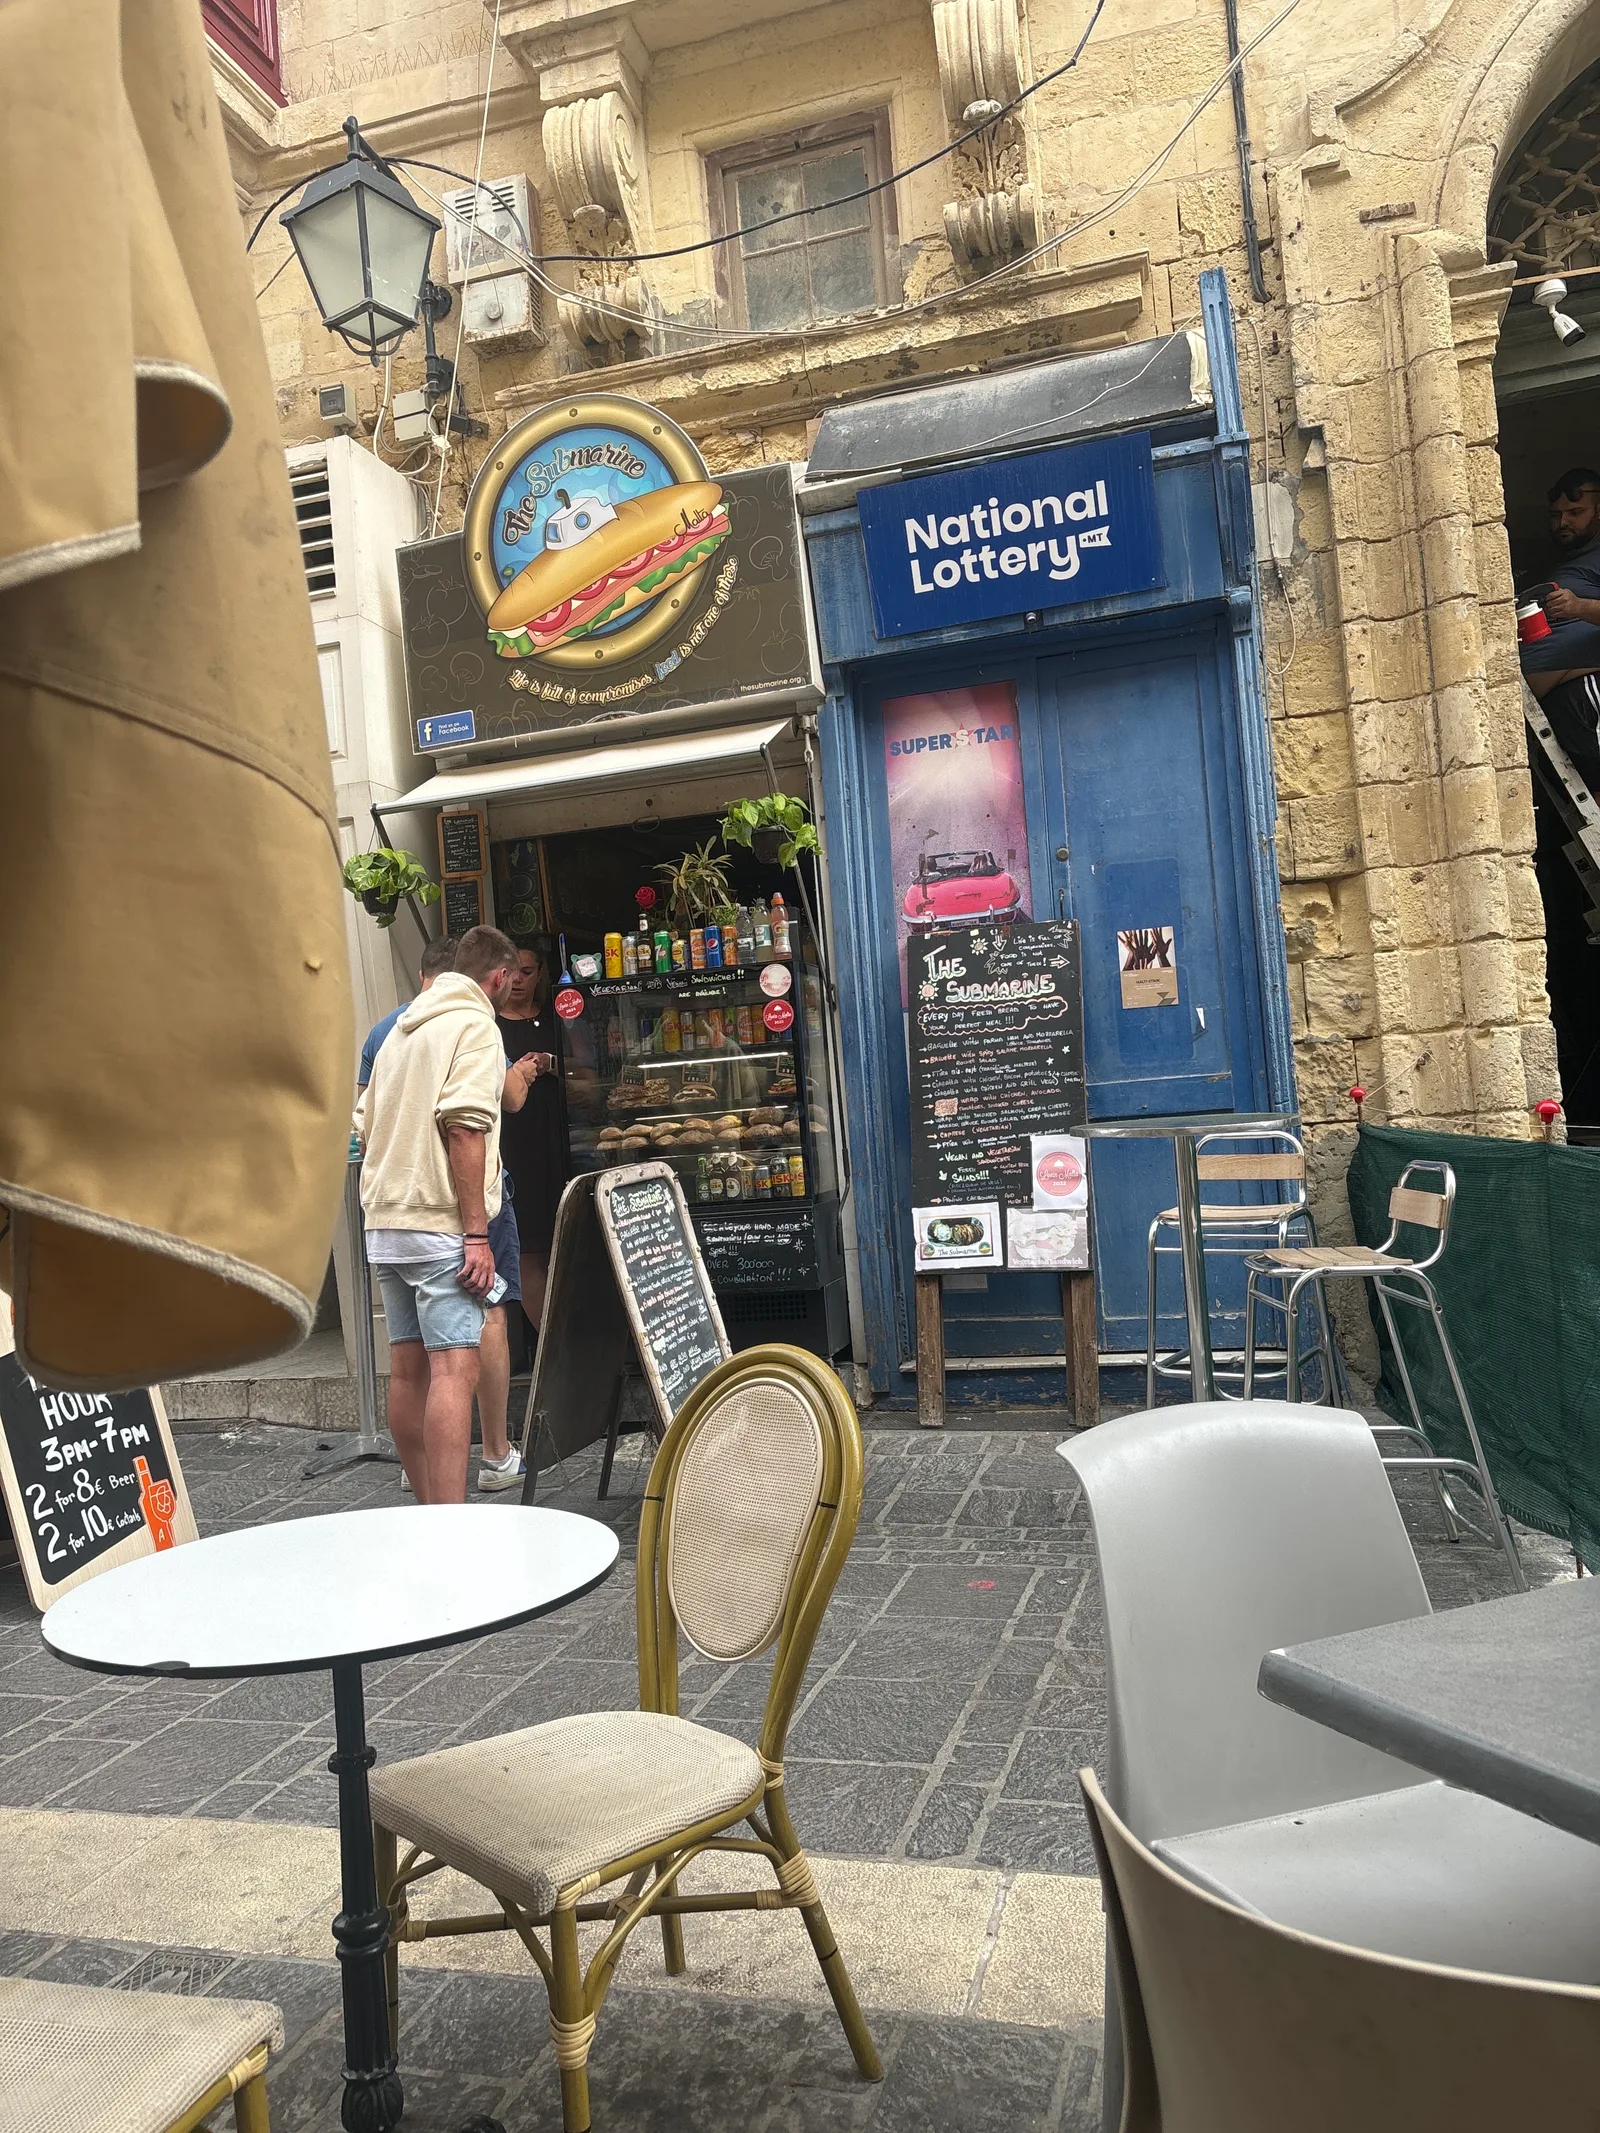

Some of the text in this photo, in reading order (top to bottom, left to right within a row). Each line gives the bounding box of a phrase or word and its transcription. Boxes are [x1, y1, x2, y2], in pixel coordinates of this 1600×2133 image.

[503, 443, 646, 545] The Submarine
[674, 508, 708, 536] Malta
[905, 480, 1109, 553] National
[716, 555, 739, 591] these
[910, 534, 1081, 595] Lottery
[714, 587, 731, 606] of
[704, 605, 721, 629] one
[689, 621, 708, 648] not
[678, 643, 693, 659] is
[654, 651, 681, 681] food
[508, 669, 529, 690] Life
[529, 678, 540, 695] is
[740, 676, 802, 692] thesubmarine.org
[540, 681, 563, 702] full
[565, 688, 577, 705] of
[889, 725, 1014, 756] SUPERSTAR
[605, 948, 620, 958] SK
[923, 1013, 948, 1022] EVERY
[952, 1012, 964, 1021] DAY
[954, 1022, 982, 1030] PERFECT
[1036, 1030, 1074, 1038] MOZZARELLA
[939, 1124, 1012, 1138] CAPRESE (VEGETARIAN)
[945, 1152, 967, 1162] VEGAN
[987, 1146, 1021, 1156] VEGETARIAN
[756, 1180, 769, 1188] SK
[772, 1174, 790, 1183] ISK
[25, 1484, 55, 1521] 2
[55, 1490, 77, 1513] for
[38, 1522, 67, 1563] 2
[68, 1534, 85, 1555] for
